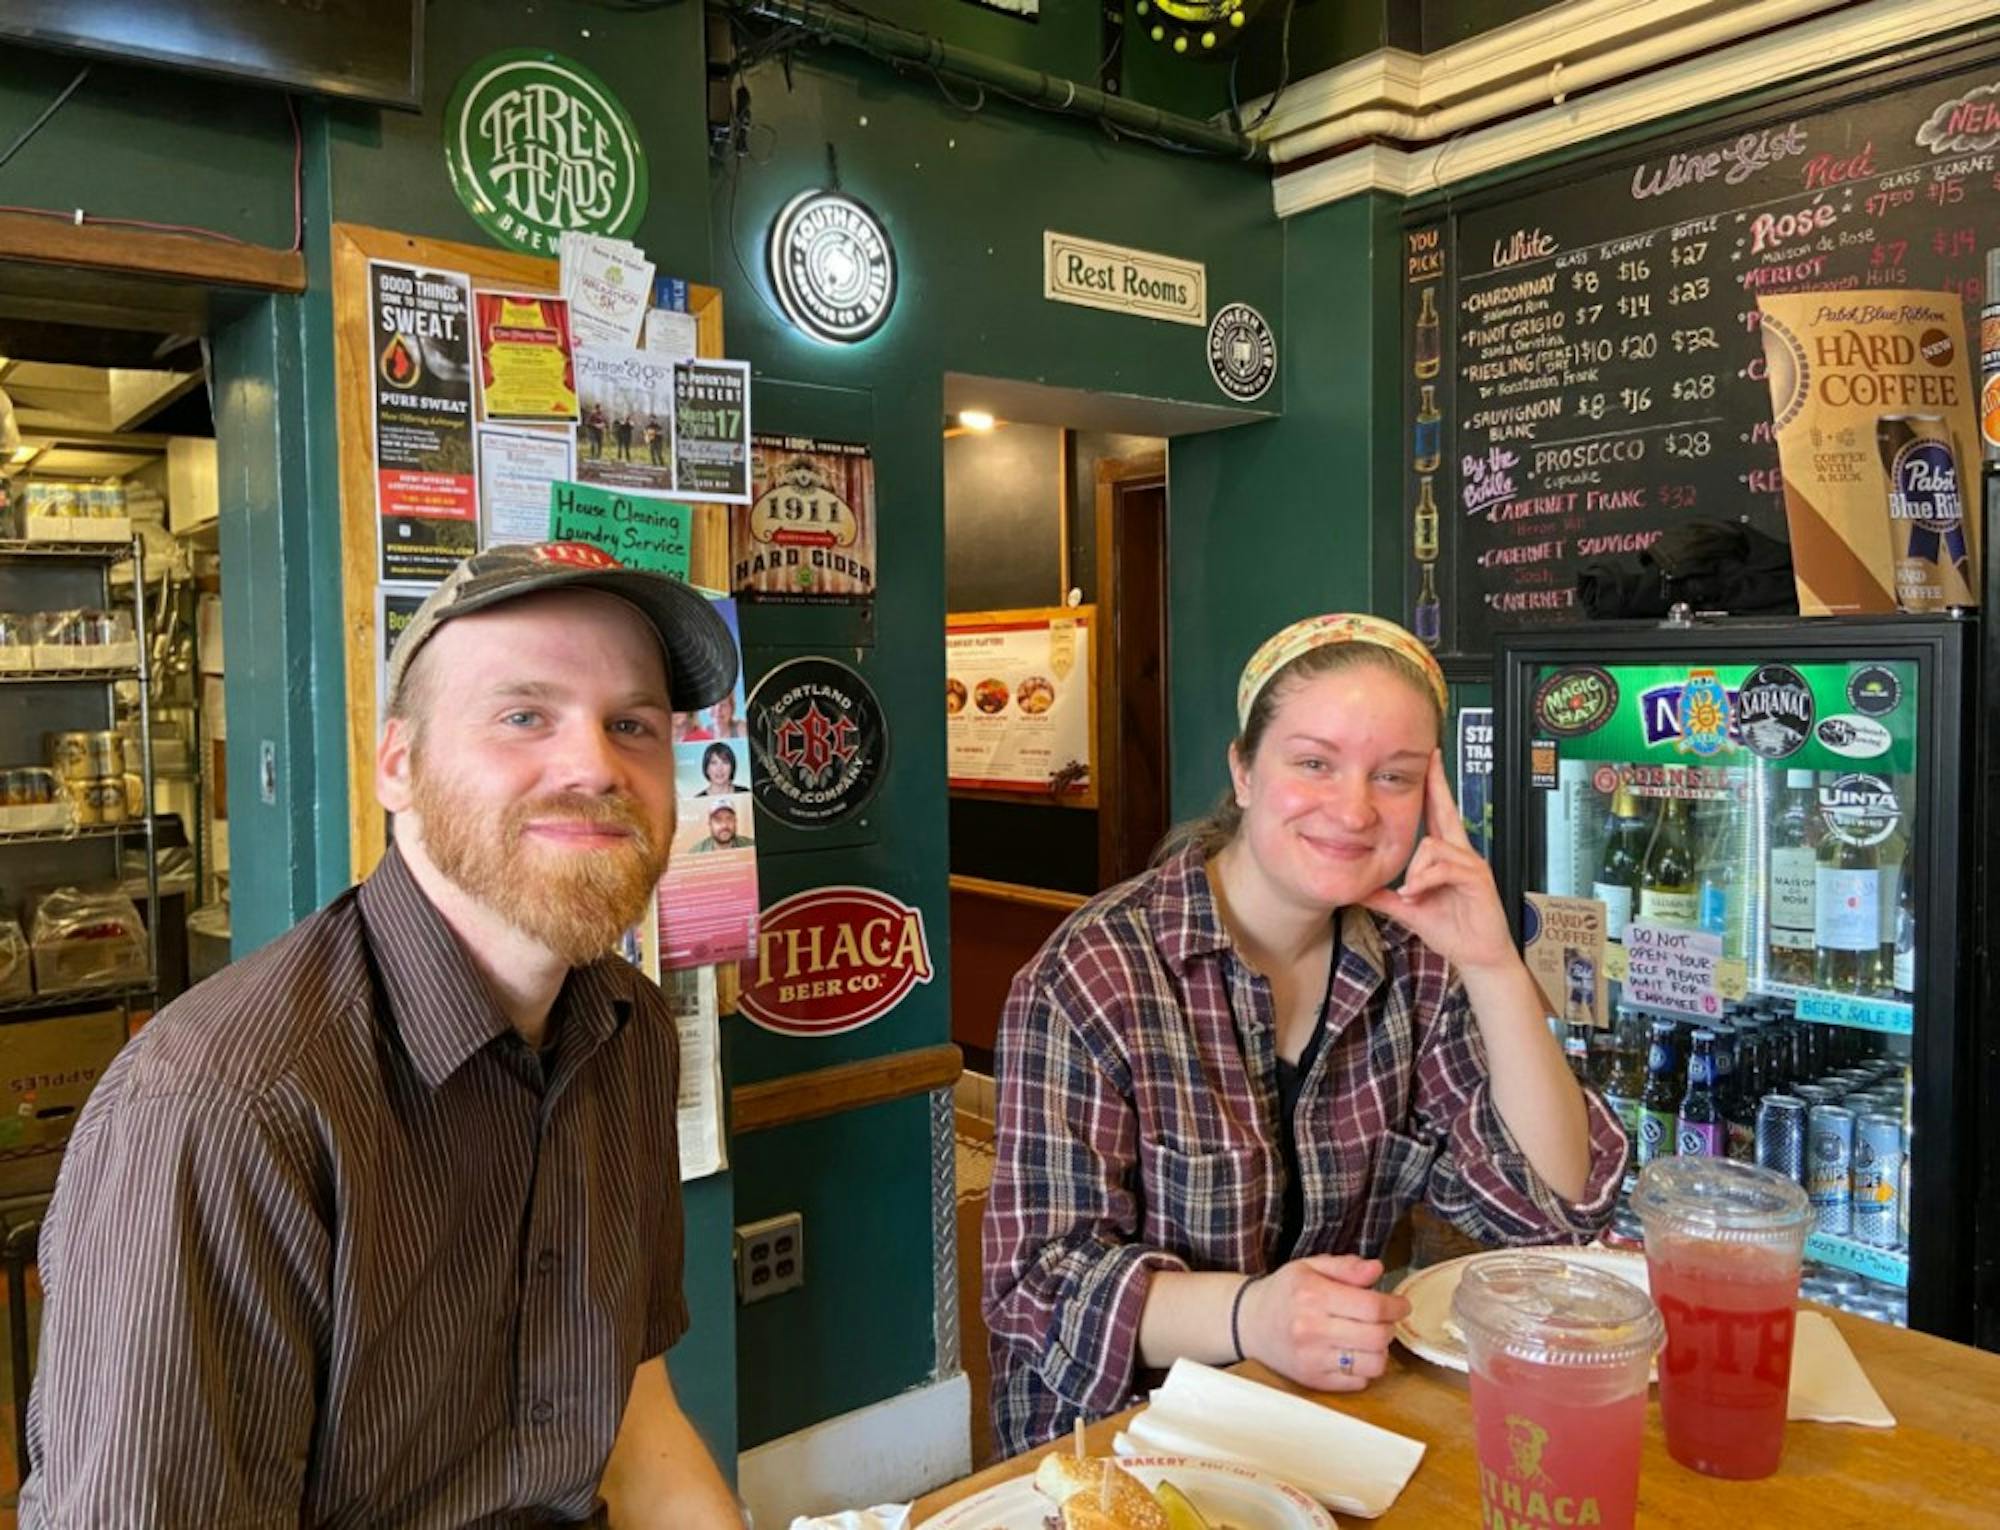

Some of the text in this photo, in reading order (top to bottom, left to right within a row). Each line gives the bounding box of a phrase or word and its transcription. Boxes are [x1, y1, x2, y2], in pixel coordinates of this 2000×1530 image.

[479, 82, 617, 171] THREE
[1631, 121, 1809, 200] Wine List
[1802, 140, 1877, 190] Red
[489, 143, 616, 228] HEADS
[1880, 168, 1922, 192] GLASS
[1926, 177, 1966, 207] $15
[1750, 192, 1838, 256] Rosé
[1409, 230, 1438, 252] YOU
[1493, 227, 1560, 269] White
[1555, 251, 1589, 269] GLASS
[1670, 214, 1719, 242] BOTTLE
[793, 204, 886, 316] SOUTHERN TIER
[1408, 249, 1445, 275] PICK!
[1743, 253, 1828, 291] MERLOT
[379, 274, 460, 302] GOOD THINGS
[1067, 253, 1188, 306] Rest Rooms
[1467, 241, 1709, 314] CHARDONNAY $8 $16 $27
[403, 296, 416, 307] TO
[1468, 276, 1711, 349] PINOT GRIGIO $7 $14 $23
[1808, 304, 1948, 326] Pabst Blue Ribbon
[381, 304, 460, 342] SWEAT.
[1212, 309, 1274, 368] SOUTHERN TIER
[1468, 352, 1535, 383] RIESLING
[1620, 332, 1658, 360] $20
[1671, 326, 1721, 355] $32
[1815, 329, 1916, 373] HARD
[380, 391, 469, 414] PURE SWEAT
[677, 385, 742, 403] CONCERT
[1473, 373, 1716, 430] SAUVIGNON $8 $16 $28
[1818, 373, 1960, 407] COFFEE
[715, 408, 741, 439] 17
[1489, 422, 1538, 442] BLANC
[1462, 445, 1521, 483] By the
[1535, 438, 1645, 475] PROSECCO
[1665, 430, 1712, 460] $28
[1463, 470, 1519, 509] Bottle
[1904, 460, 1957, 492] Pabst
[557, 488, 681, 539] House Cleaning
[767, 496, 841, 522] 1911
[1490, 493, 1579, 524] CABERNET
[1586, 488, 1649, 512] FRANC
[1888, 492, 1934, 520] Blue
[554, 516, 686, 557] Laundry Service
[735, 548, 871, 588] HARD CIDER
[1484, 540, 1568, 568] CABERNET
[1491, 587, 1578, 613] CABERNET
[772, 682, 852, 715] CORTLAND
[1545, 675, 1600, 710] MAGIC
[1740, 689, 1811, 722] SARANAC
[1557, 698, 1600, 725] HAT
[773, 699, 859, 777] CBC
[1620, 765, 1728, 788] CORNELL
[1818, 787, 1899, 810] UINTA
[1546, 911, 1584, 930] HARD
[754, 914, 928, 989] THACA
[1545, 927, 1598, 947] COFFEE
[1634, 928, 1689, 949] DO NOT
[1629, 948, 1668, 963] OPEN
[1629, 960, 1711, 985] SELF PLEASE
[1629, 976, 1699, 995] WAIT FOR
[778, 979, 844, 1004] BEER
[1635, 990, 1700, 1012] EMPLOYEE
[1802, 1000, 1842, 1020] BEER
[1847, 1004, 1887, 1026] SALE
[10, 1068, 96, 1093] APPLES
[1122, 1456, 1188, 1467] BAKERY
